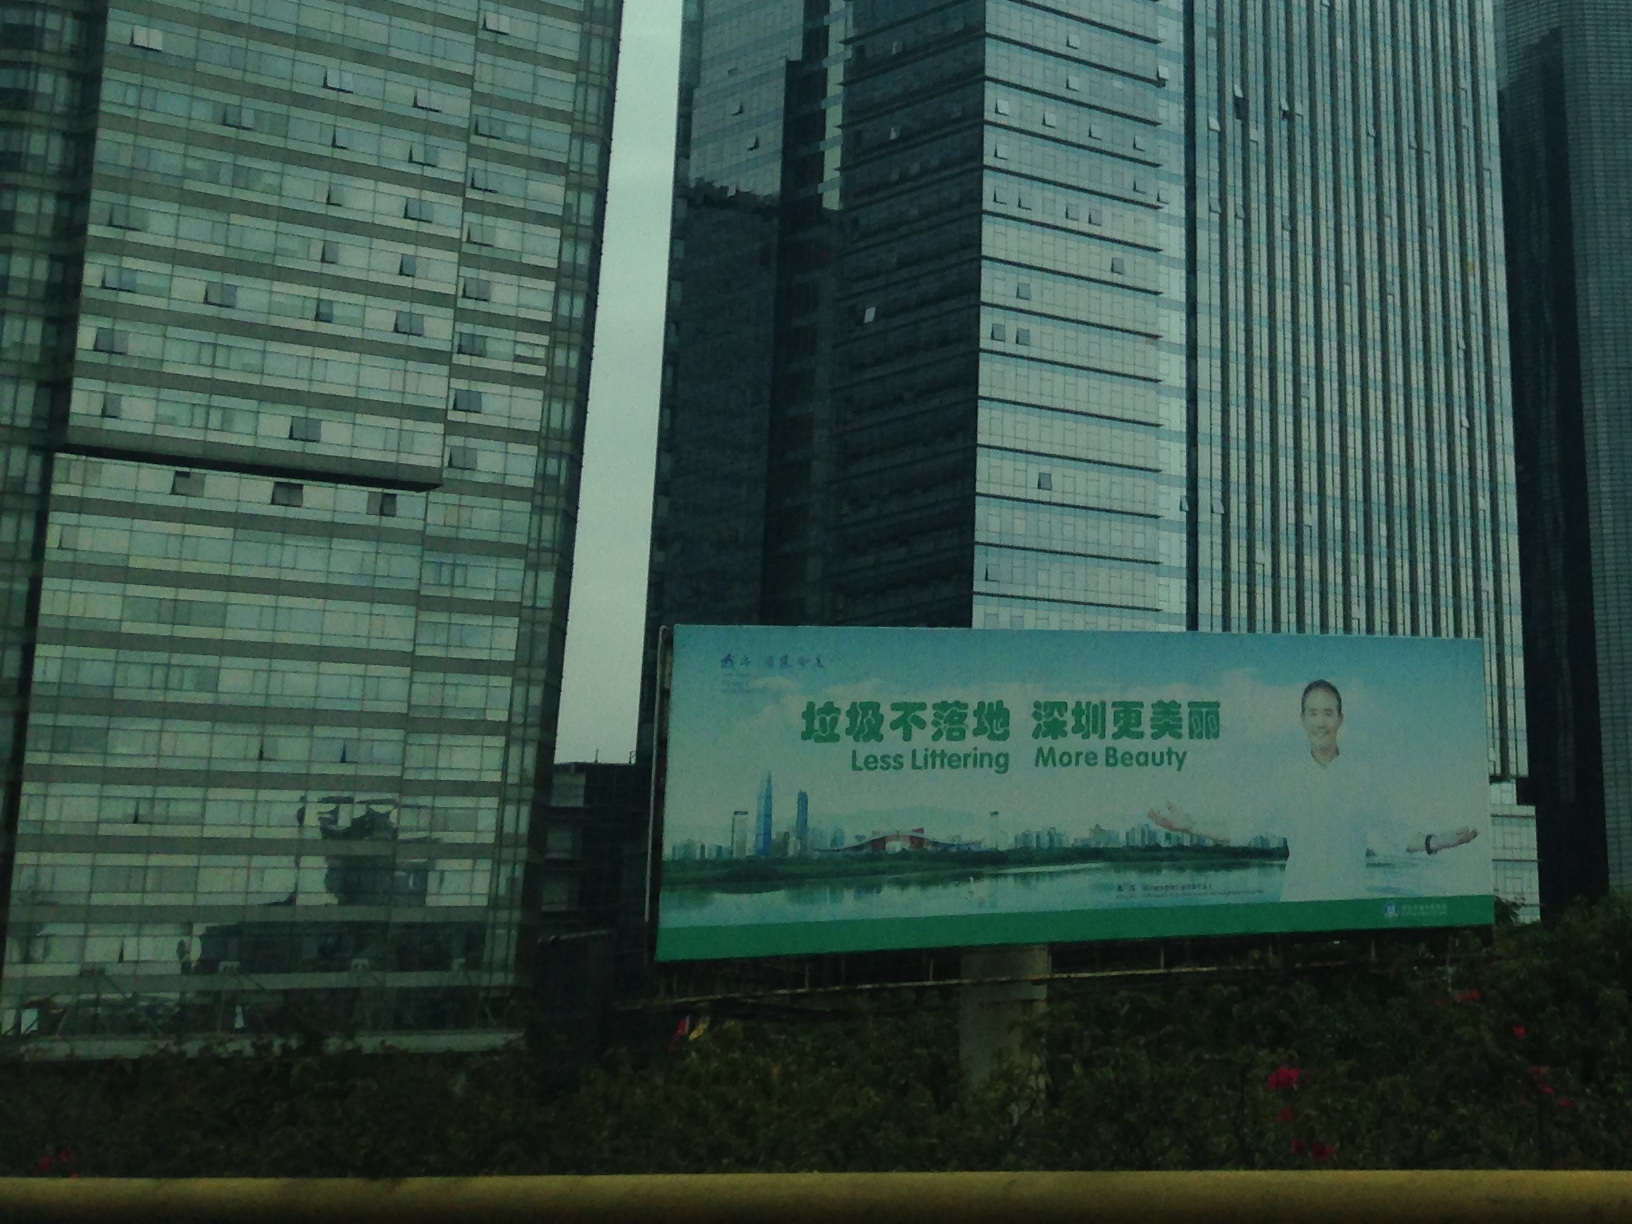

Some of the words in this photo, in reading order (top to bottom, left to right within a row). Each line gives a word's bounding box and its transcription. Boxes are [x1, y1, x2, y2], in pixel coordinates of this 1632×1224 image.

[801, 700, 1011, 743] 垃圾不落地
[1031, 699, 1220, 741] 深圳更美丽
[851, 749, 904, 772] Less
[911, 746, 1010, 775] Littering
[1034, 746, 1099, 768] More
[1104, 746, 1188, 772] Beauty
